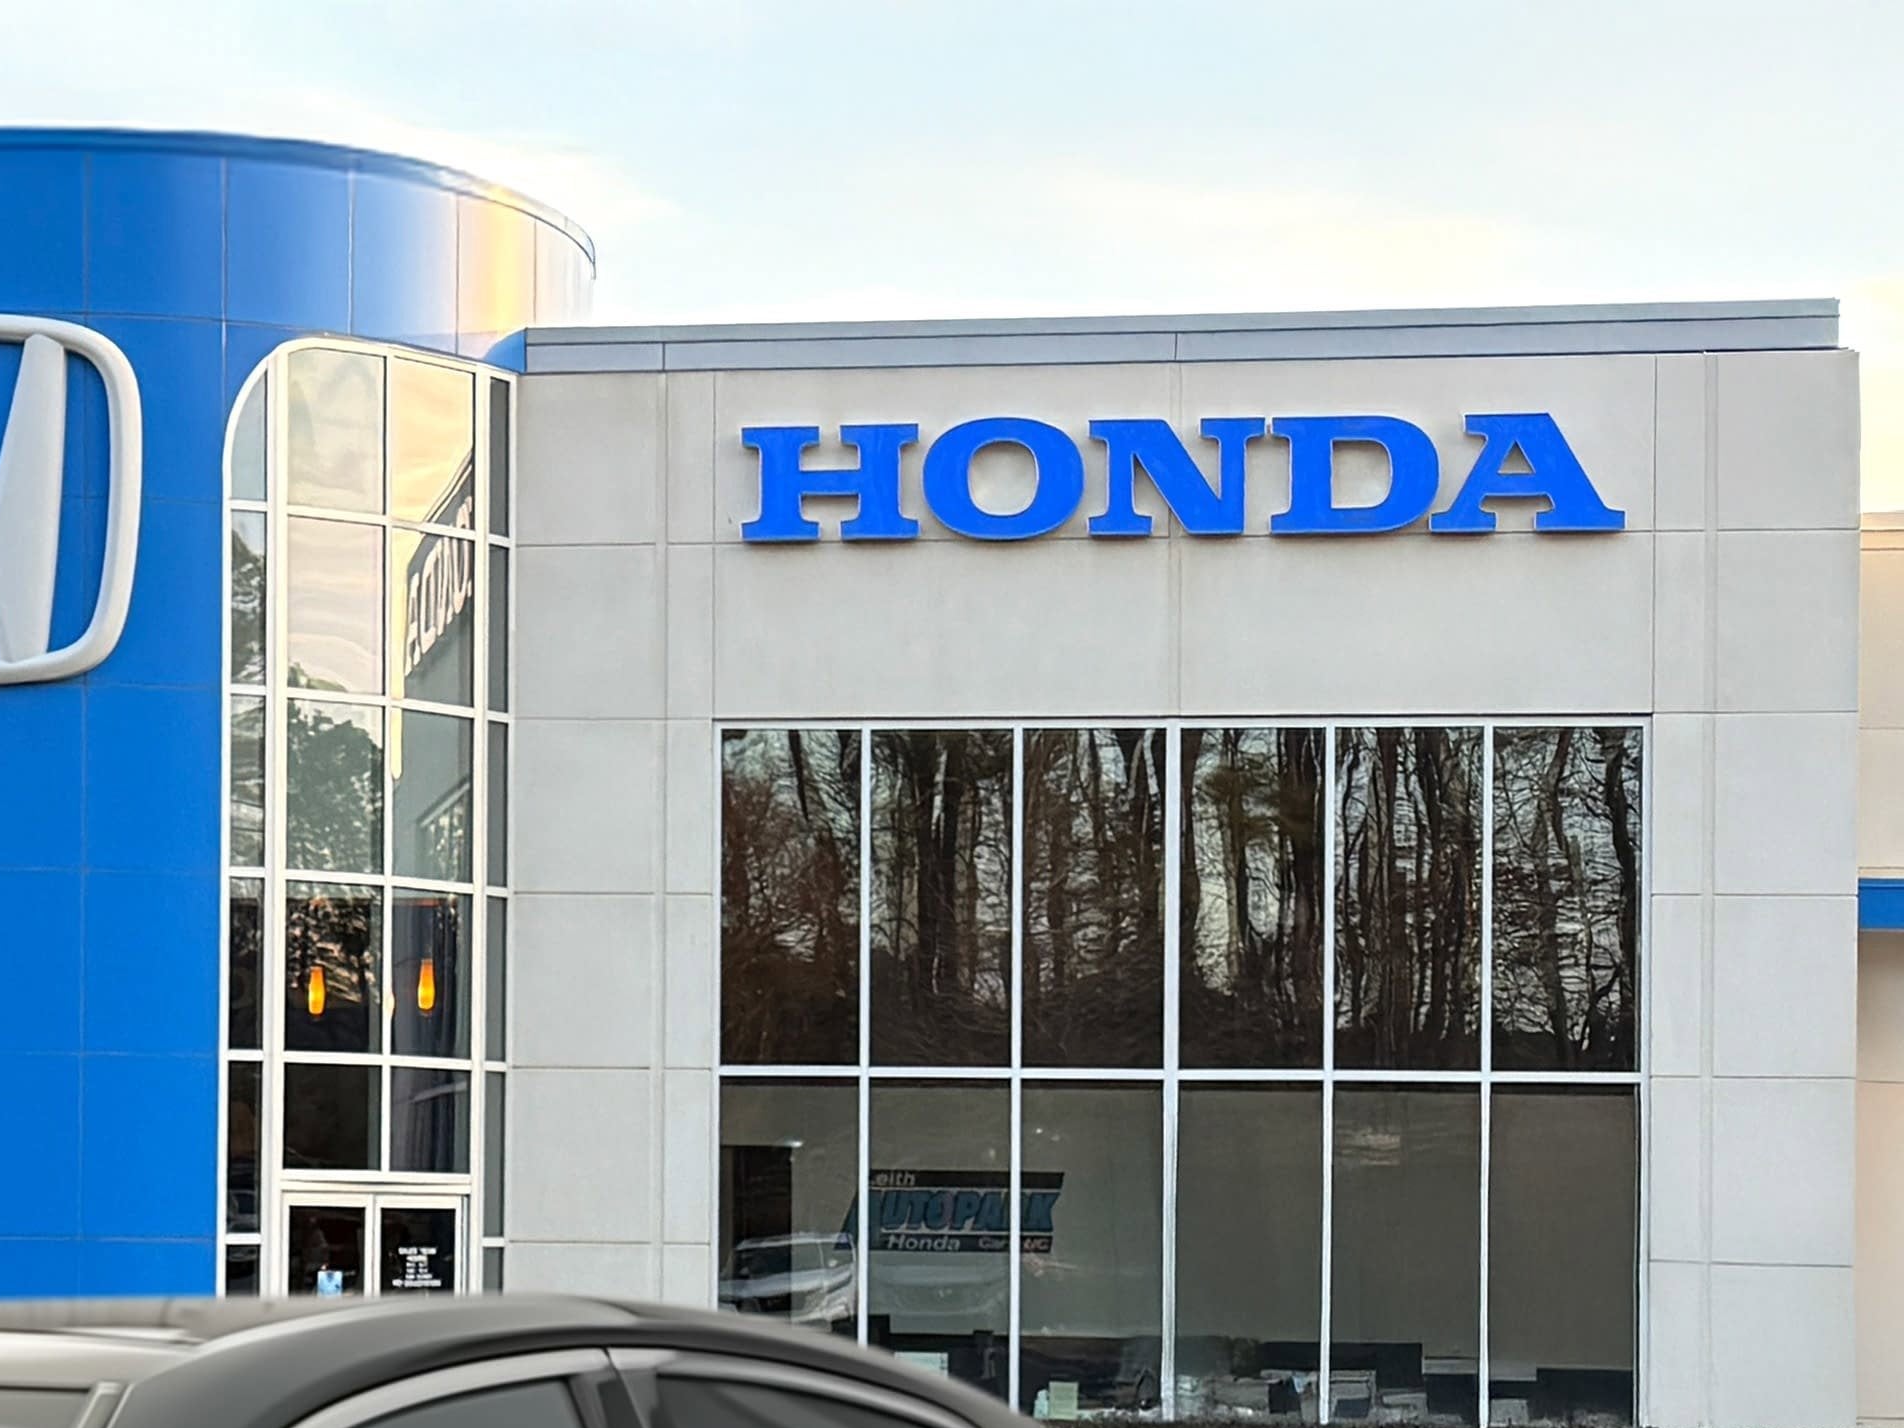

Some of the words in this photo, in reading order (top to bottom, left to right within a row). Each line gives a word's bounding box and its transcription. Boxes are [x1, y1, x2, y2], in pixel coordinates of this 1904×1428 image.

[741, 412, 1626, 542] HONDA
[870, 1171, 916, 1186] eith
[887, 1234, 960, 1251] Honda
